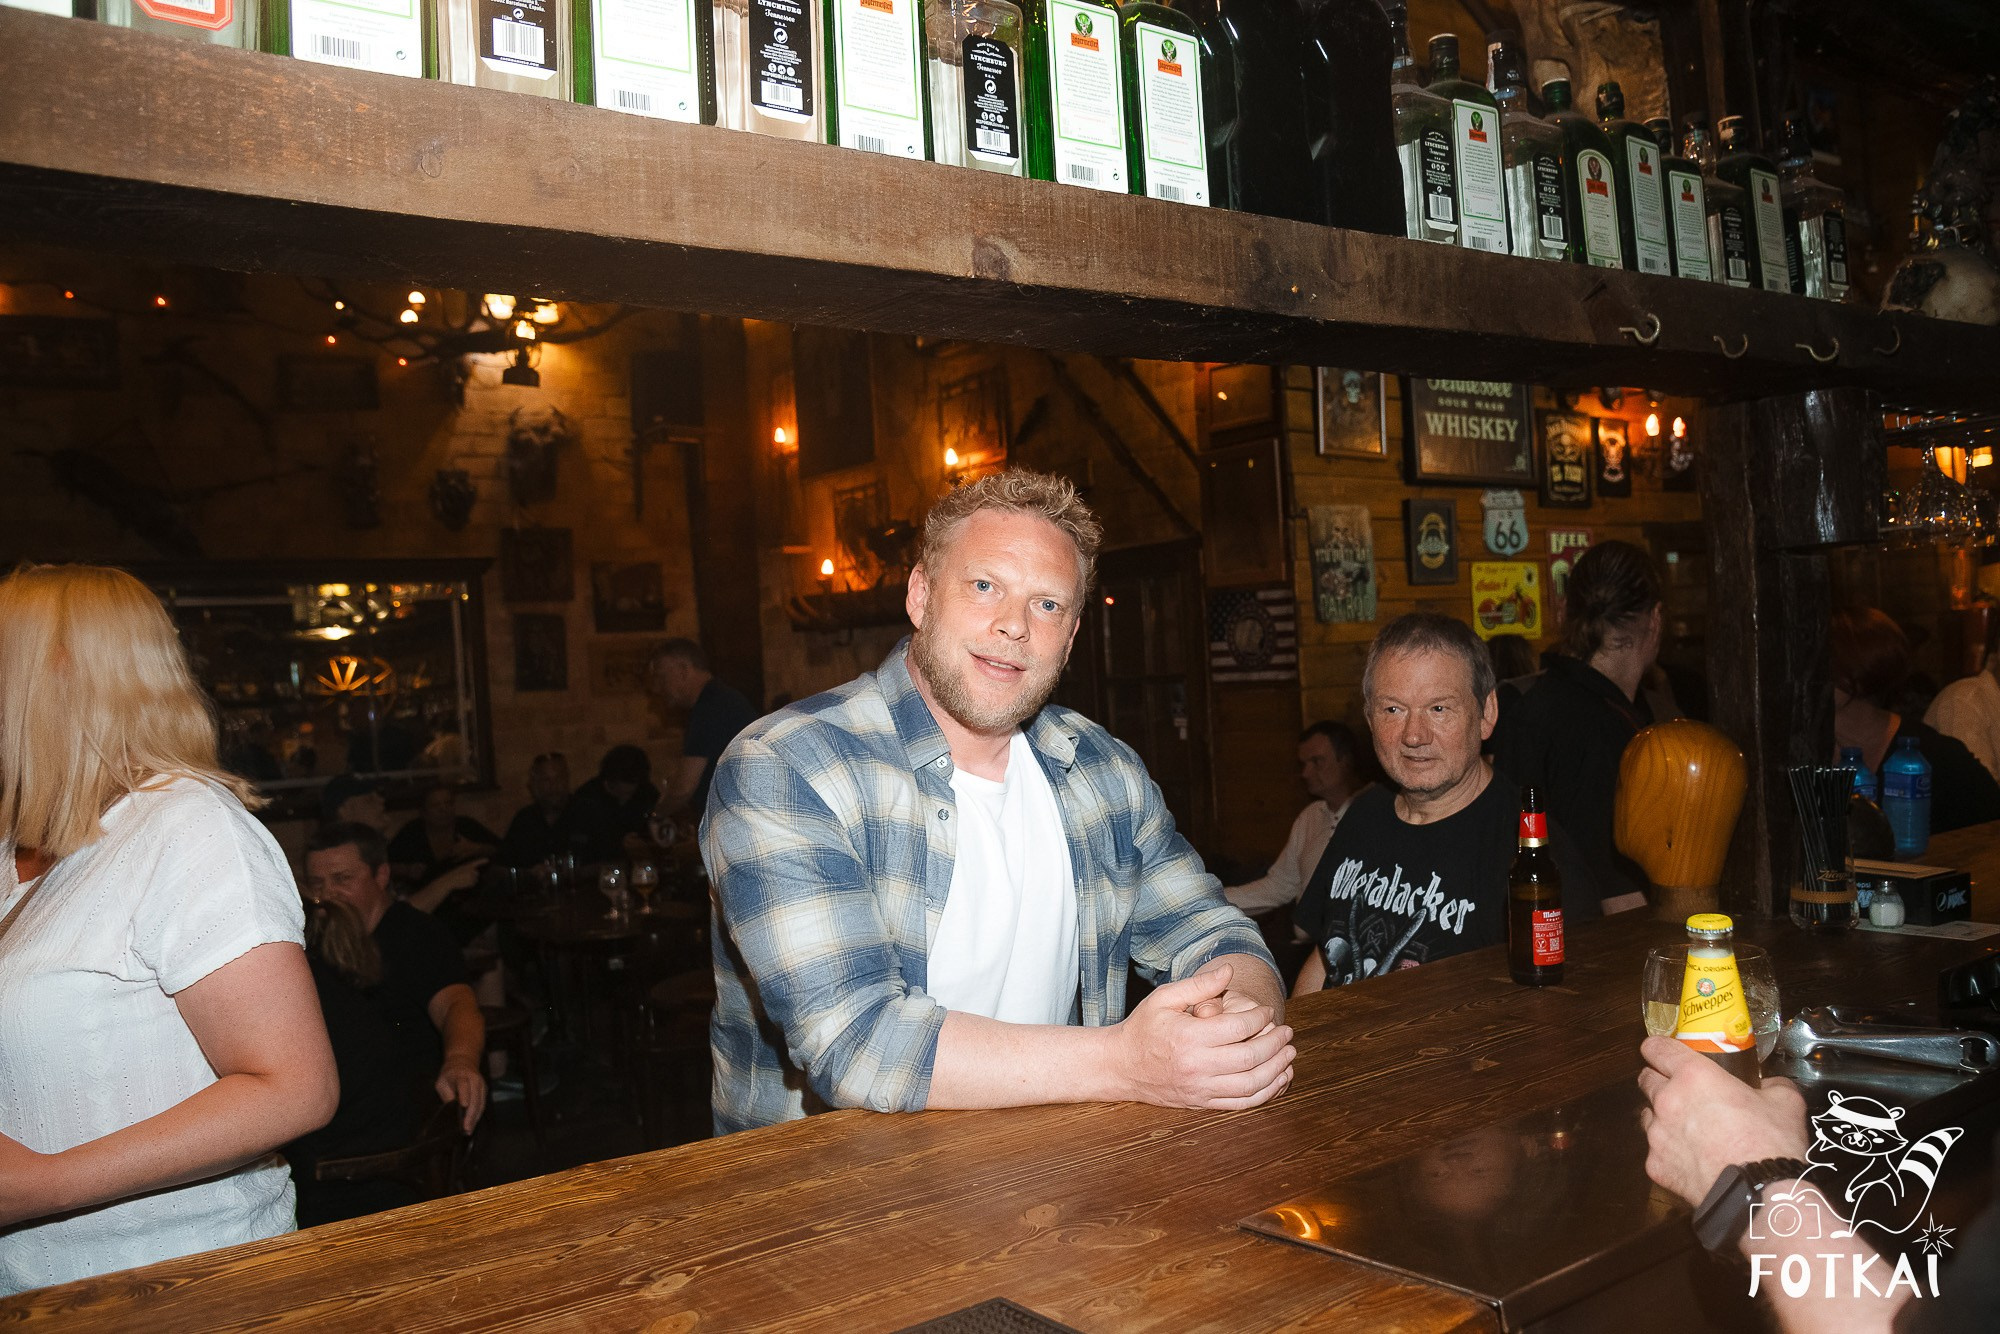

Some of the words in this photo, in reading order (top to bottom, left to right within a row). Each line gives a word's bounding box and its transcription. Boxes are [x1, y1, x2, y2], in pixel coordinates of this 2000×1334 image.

[757, 0, 802, 15] LYNCHBURG
[765, 8, 796, 23] Tennessee
[970, 53, 1007, 67] LYNCHBURG
[976, 62, 1002, 75] Tennessee
[1425, 411, 1518, 442] WHISKEY
[1495, 520, 1521, 550] 66
[1330, 857, 1476, 936] Metalacker
[1704, 965, 1734, 973] ORIGINAL
[1682, 990, 1734, 1022] Schweppes
